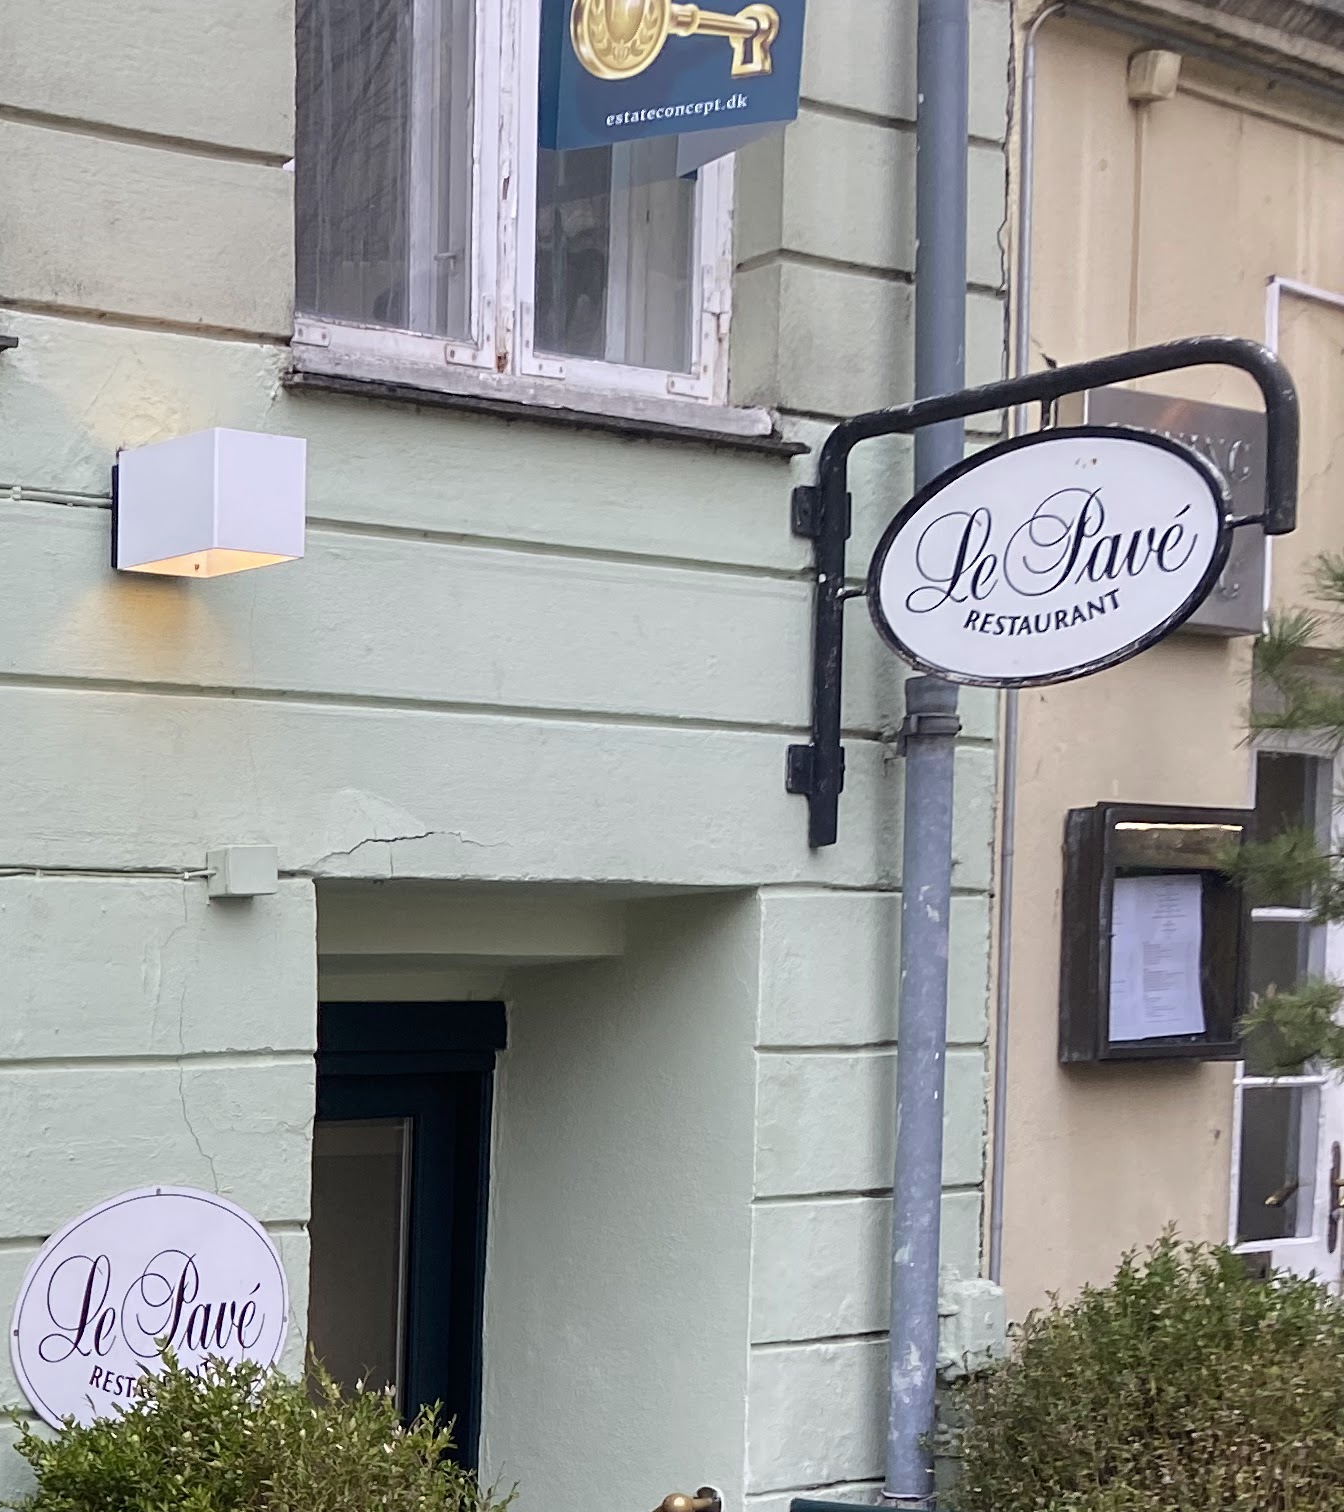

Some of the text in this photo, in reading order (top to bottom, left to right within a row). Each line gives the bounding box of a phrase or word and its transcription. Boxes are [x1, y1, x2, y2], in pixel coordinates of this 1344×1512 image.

[605, 94, 748, 127] estateconcept.dk
[905, 487, 1198, 613] Le Pavé
[964, 588, 1121, 636] RESTAURANT
[38, 1249, 266, 1363] Le Pavé
